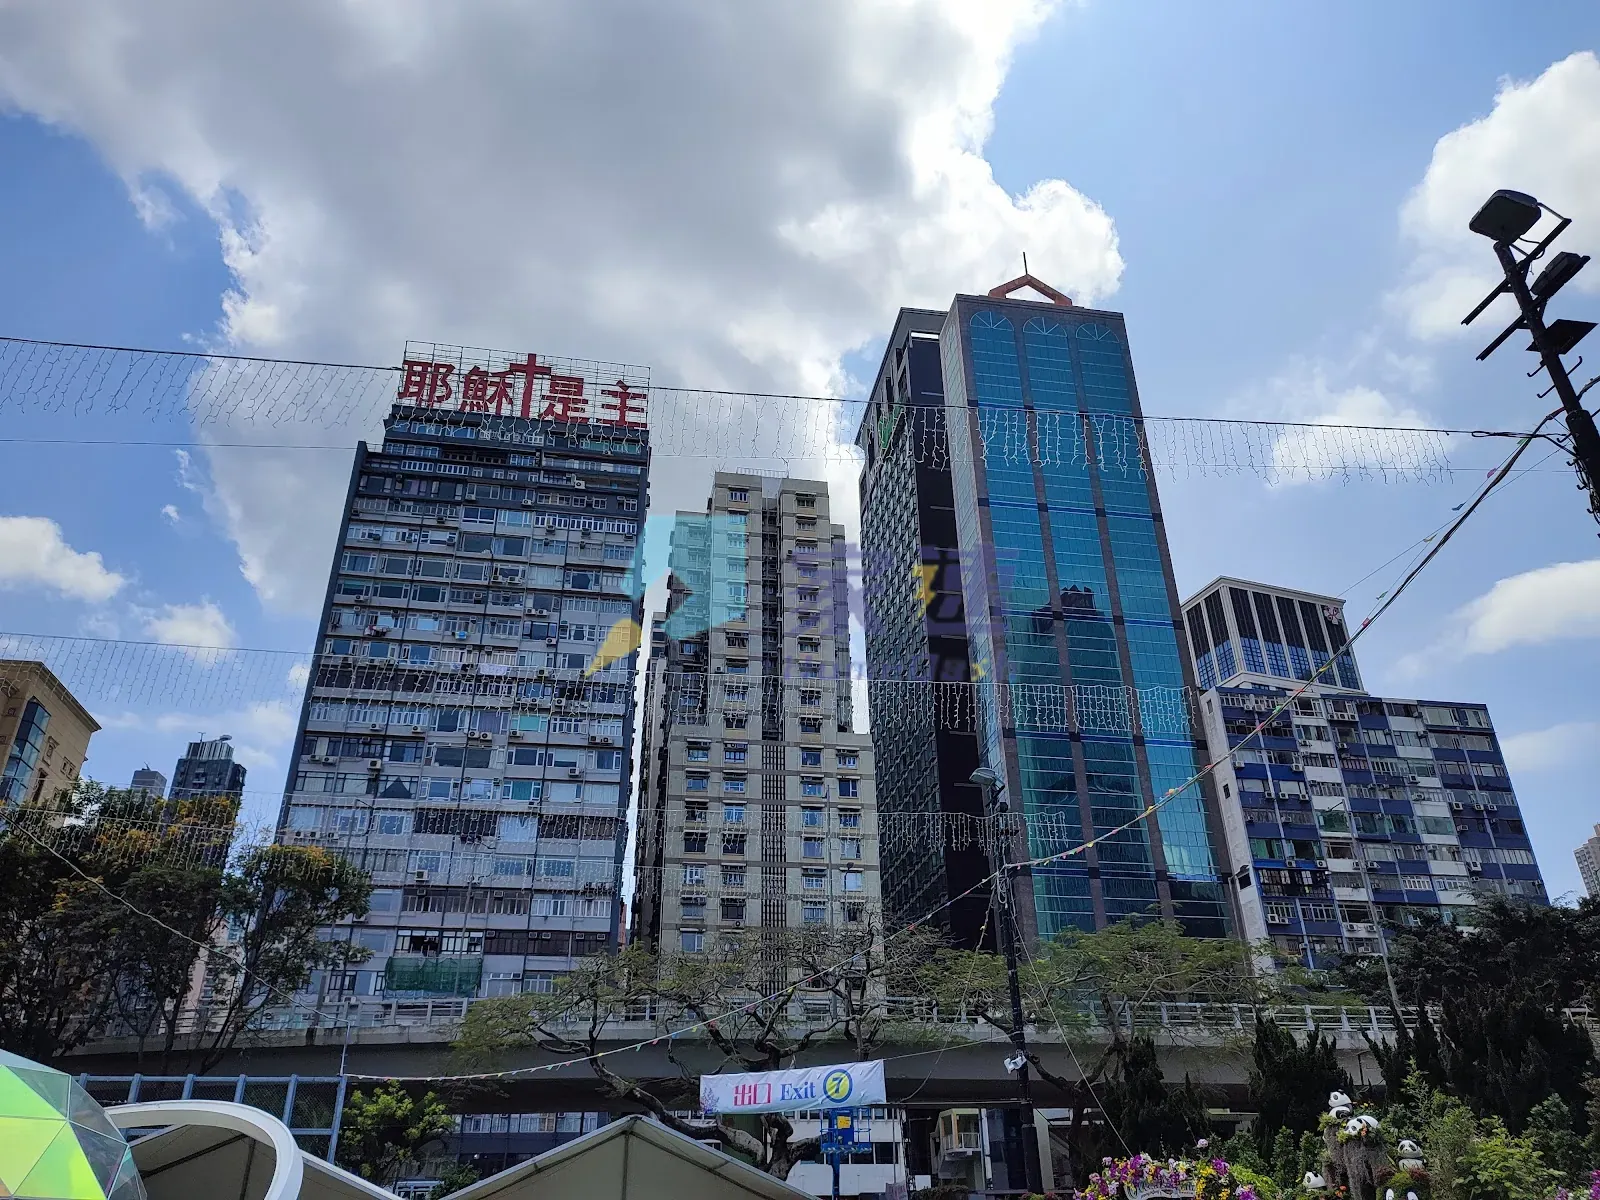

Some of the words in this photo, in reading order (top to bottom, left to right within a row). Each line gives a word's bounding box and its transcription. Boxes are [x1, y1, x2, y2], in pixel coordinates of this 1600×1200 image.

[733, 1083, 772, 1106] 出口
[780, 1081, 816, 1101] Exit
[831, 1076, 844, 1094] 7
